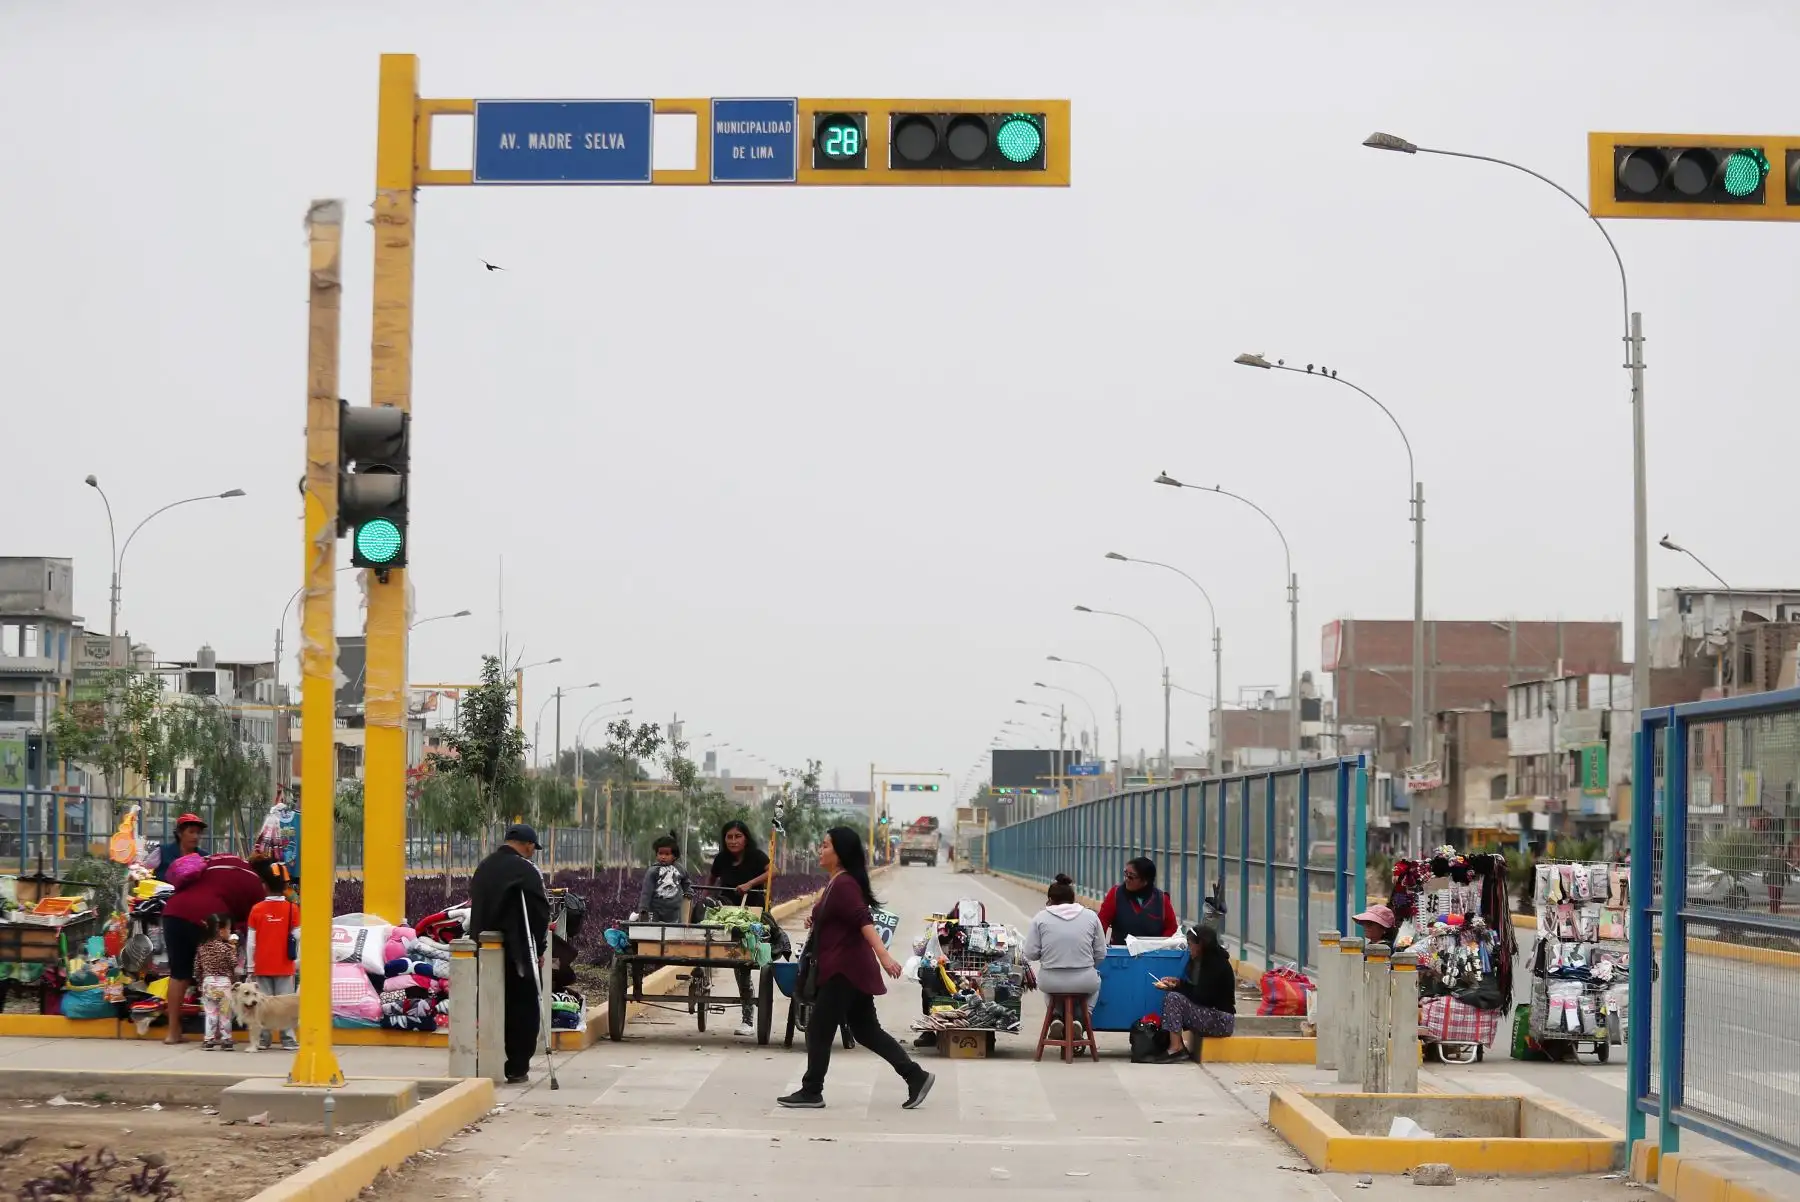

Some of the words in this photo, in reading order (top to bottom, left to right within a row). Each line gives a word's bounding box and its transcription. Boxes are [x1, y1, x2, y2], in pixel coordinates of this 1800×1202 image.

[716, 121, 792, 134] MUNICIPALIDAD
[499, 133, 521, 150] AV.
[529, 133, 572, 150] MADRE
[584, 133, 625, 150] SELVA
[826, 127, 858, 155] 28
[732, 146, 745, 159] DE
[751, 146, 774, 159] LIMA
